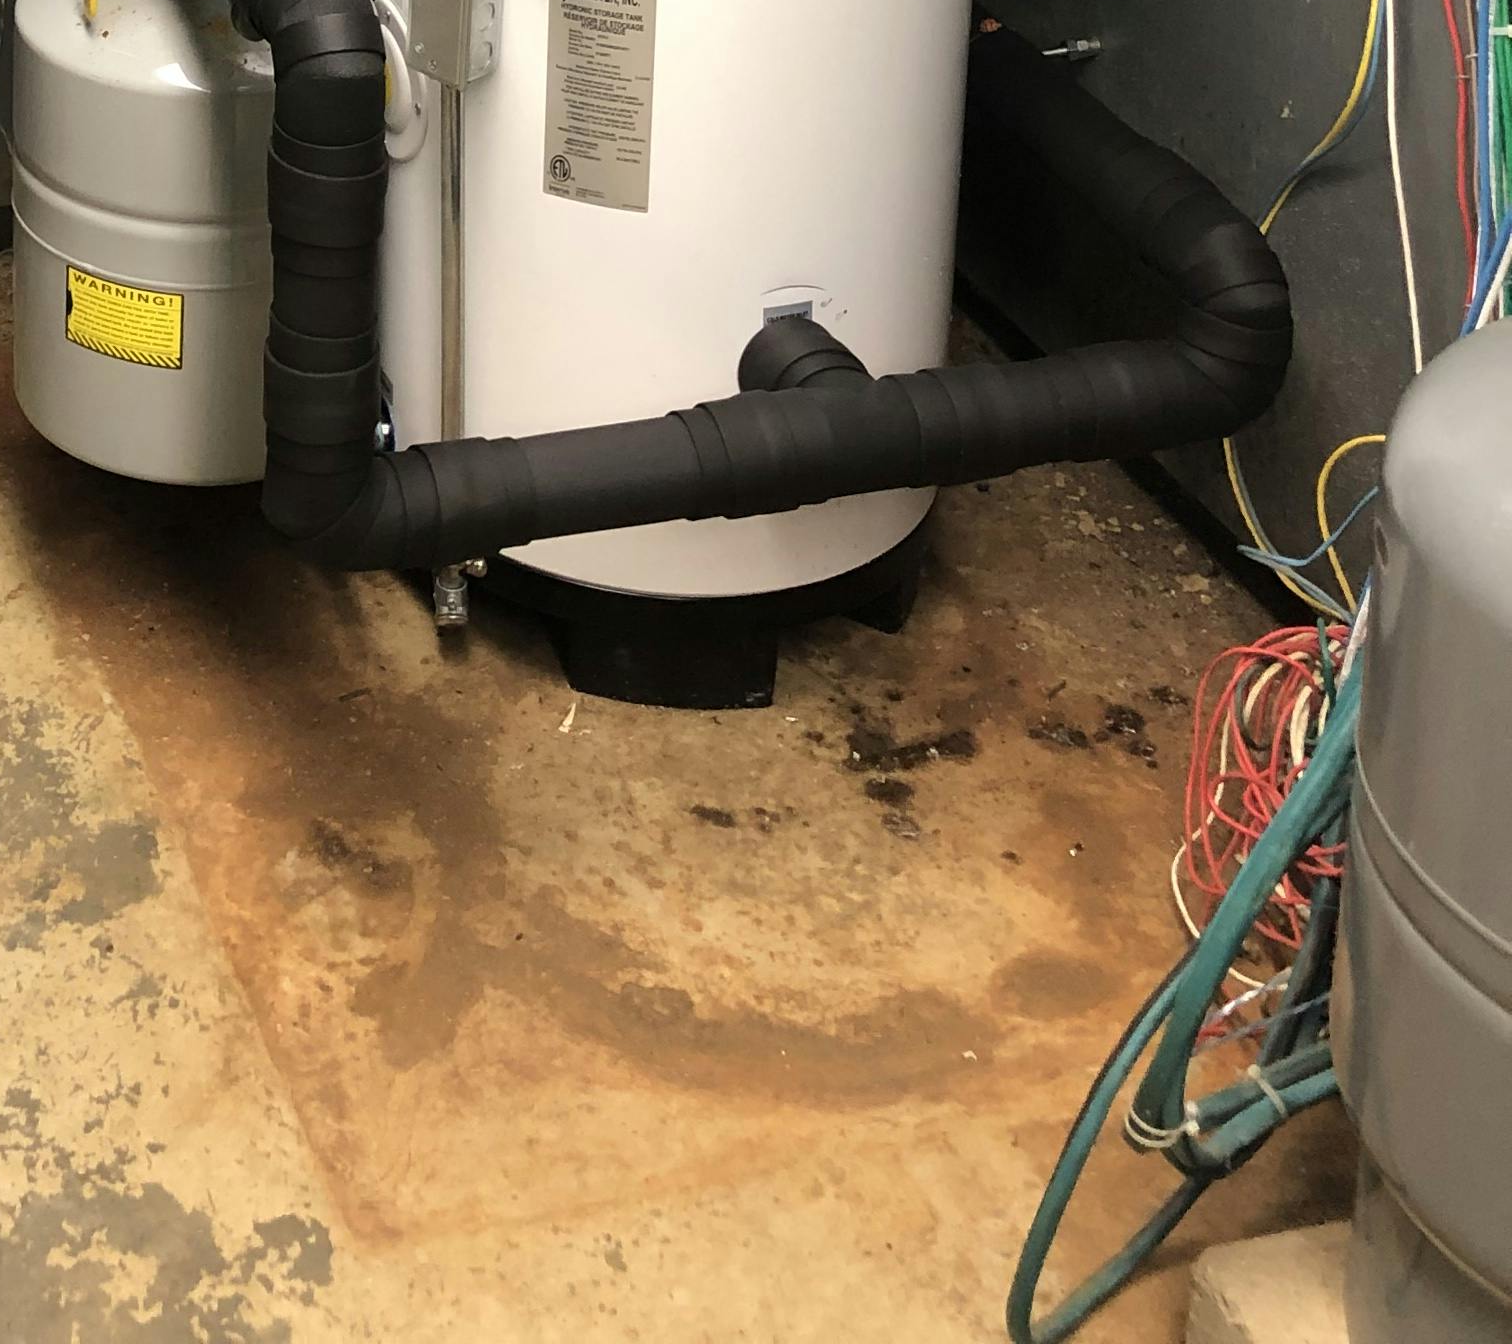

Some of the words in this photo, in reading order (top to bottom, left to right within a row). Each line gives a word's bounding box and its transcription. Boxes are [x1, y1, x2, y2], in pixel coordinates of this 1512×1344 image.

[594, 9, 624, 19] STORAGE
[626, 14, 643, 22] TANK
[74, 272, 173, 307] WARNING!
